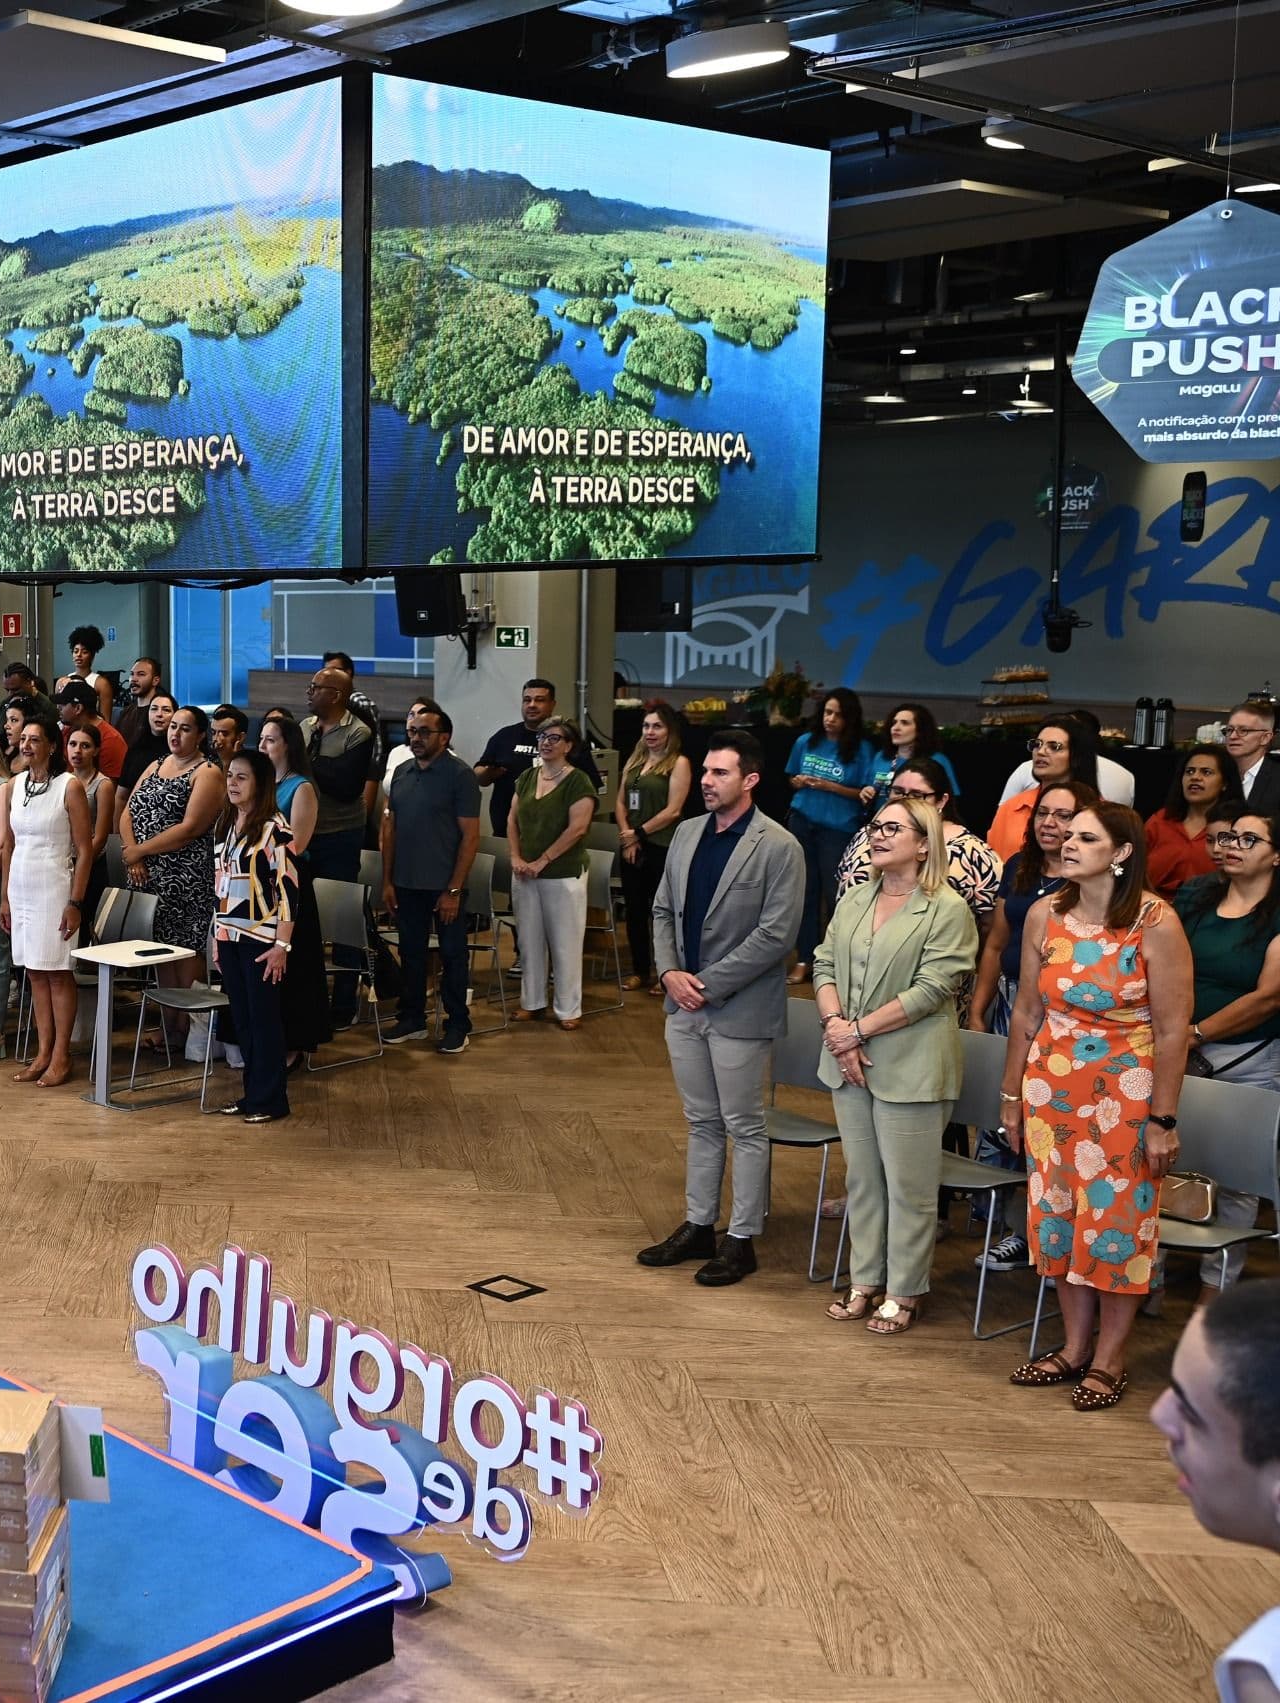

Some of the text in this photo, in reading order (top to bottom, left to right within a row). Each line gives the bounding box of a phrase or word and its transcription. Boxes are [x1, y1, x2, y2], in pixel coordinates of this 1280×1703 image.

[1131, 334, 1280, 378] PUSH
[1137, 418, 1147, 428] A
[1149, 415, 1216, 428] notificação
[1218, 416, 1245, 425] com
[1247, 414, 1256, 423] o
[1144, 432, 1174, 442] mais
[1176, 430, 1229, 441] absurdo
[1230, 428, 1248, 439] da
[51, 448, 62, 474] E
[68, 446, 96, 473] DE
[102, 434, 244, 471] ESPERANÇA,
[463, 426, 752, 464] DE AMOR E DE ESPERANÇA,
[529, 467, 695, 503] À TERRA DESCE
[1047, 485, 1094, 497] BACK
[12, 487, 176, 520] À TERRA DESCE
